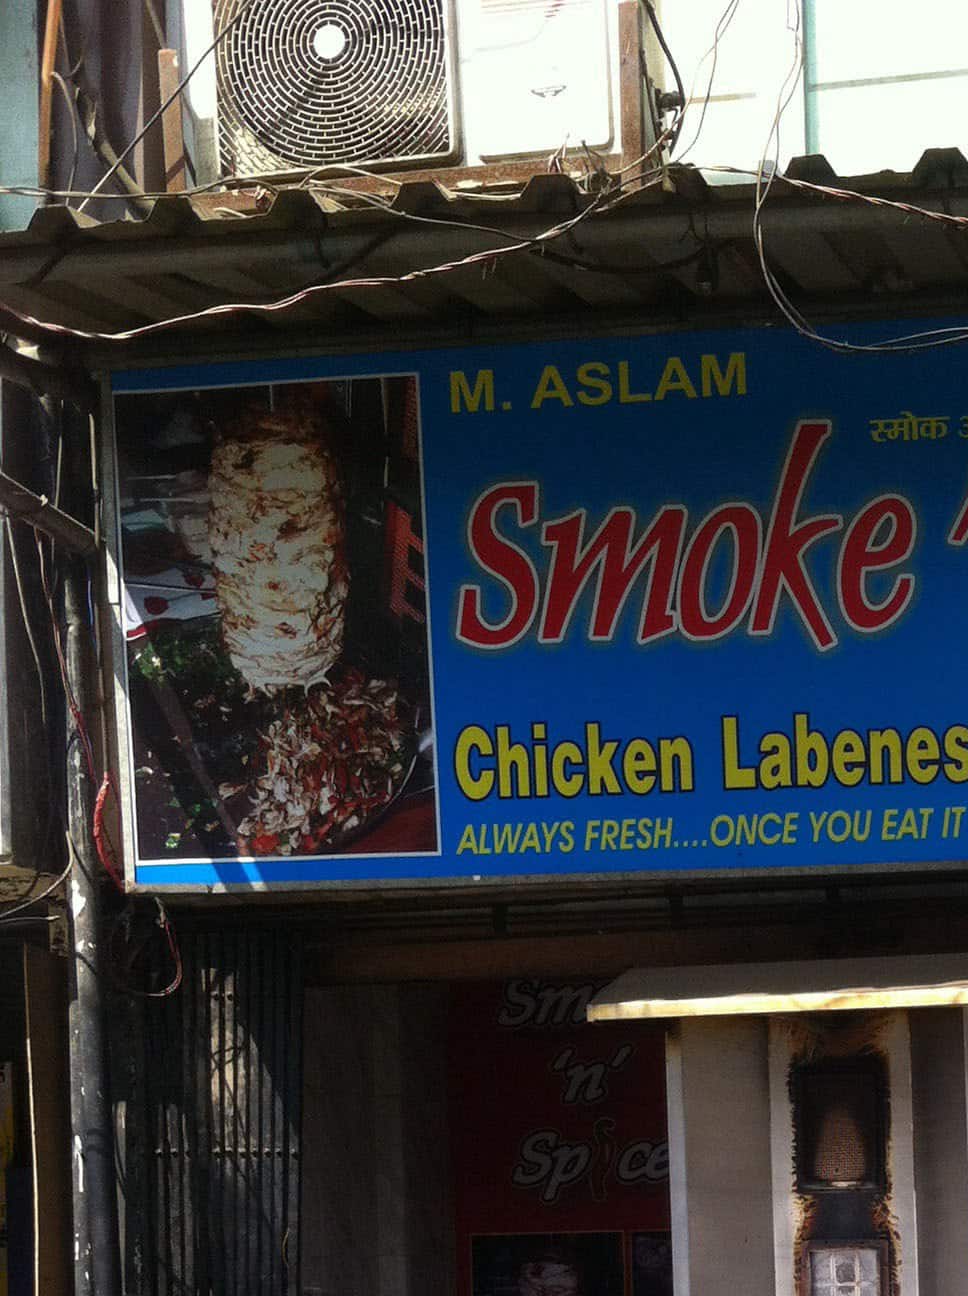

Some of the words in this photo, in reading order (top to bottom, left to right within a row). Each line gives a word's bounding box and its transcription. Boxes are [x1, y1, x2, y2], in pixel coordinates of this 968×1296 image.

[449, 369, 511, 413] M.
[531, 352, 747, 409] ASLAM
[869, 410, 951, 442] स्मोक
[456, 419, 917, 652] Smoke
[454, 722, 694, 800] Chicken
[456, 821, 575, 855] ALWAYS
[809, 809, 871, 843] YOU
[881, 807, 934, 841] EAT
[941, 807, 966, 838] IT
